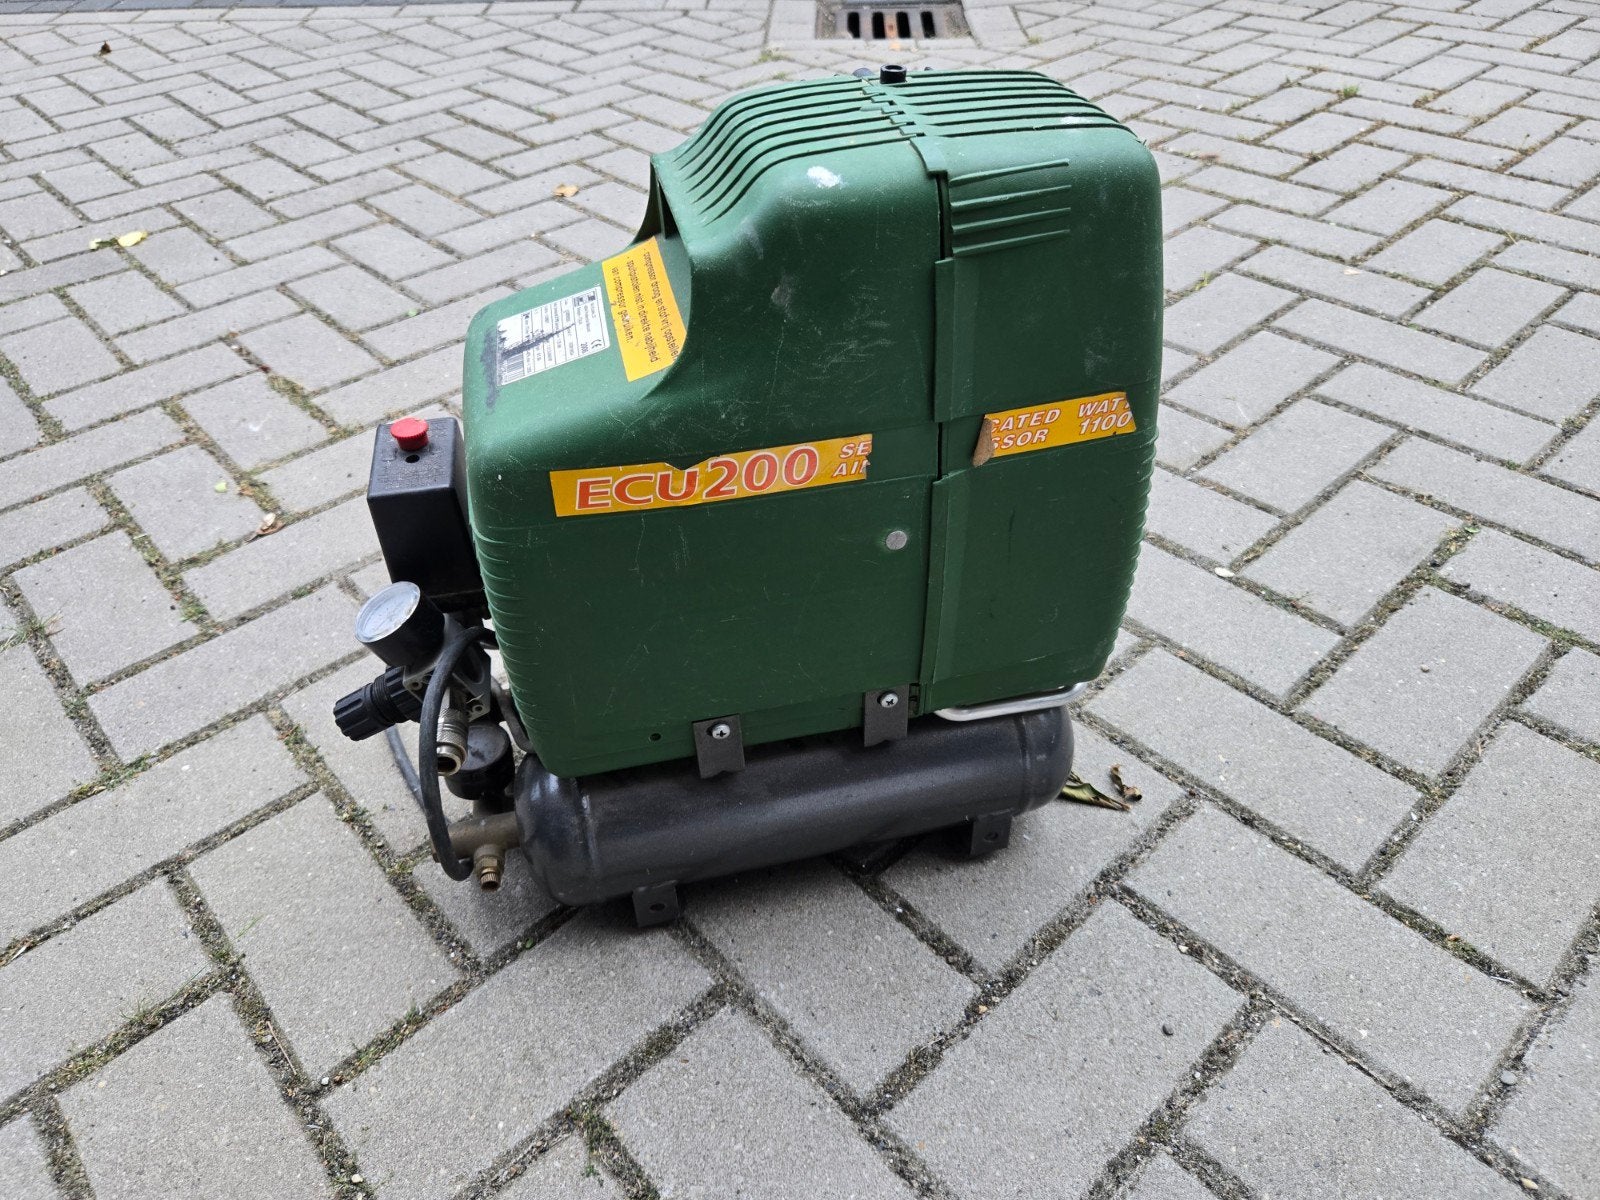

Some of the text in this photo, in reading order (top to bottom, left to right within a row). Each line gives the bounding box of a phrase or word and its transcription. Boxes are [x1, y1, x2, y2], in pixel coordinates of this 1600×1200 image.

[643, 251, 656, 281] compressor
[650, 280, 662, 300] droog
[613, 276, 626, 310] compressor
[638, 309, 652, 333] direkte
[643, 330, 660, 363] nabijheid
[1079, 411, 1132, 435] 1100
[575, 445, 819, 510] ECU200
